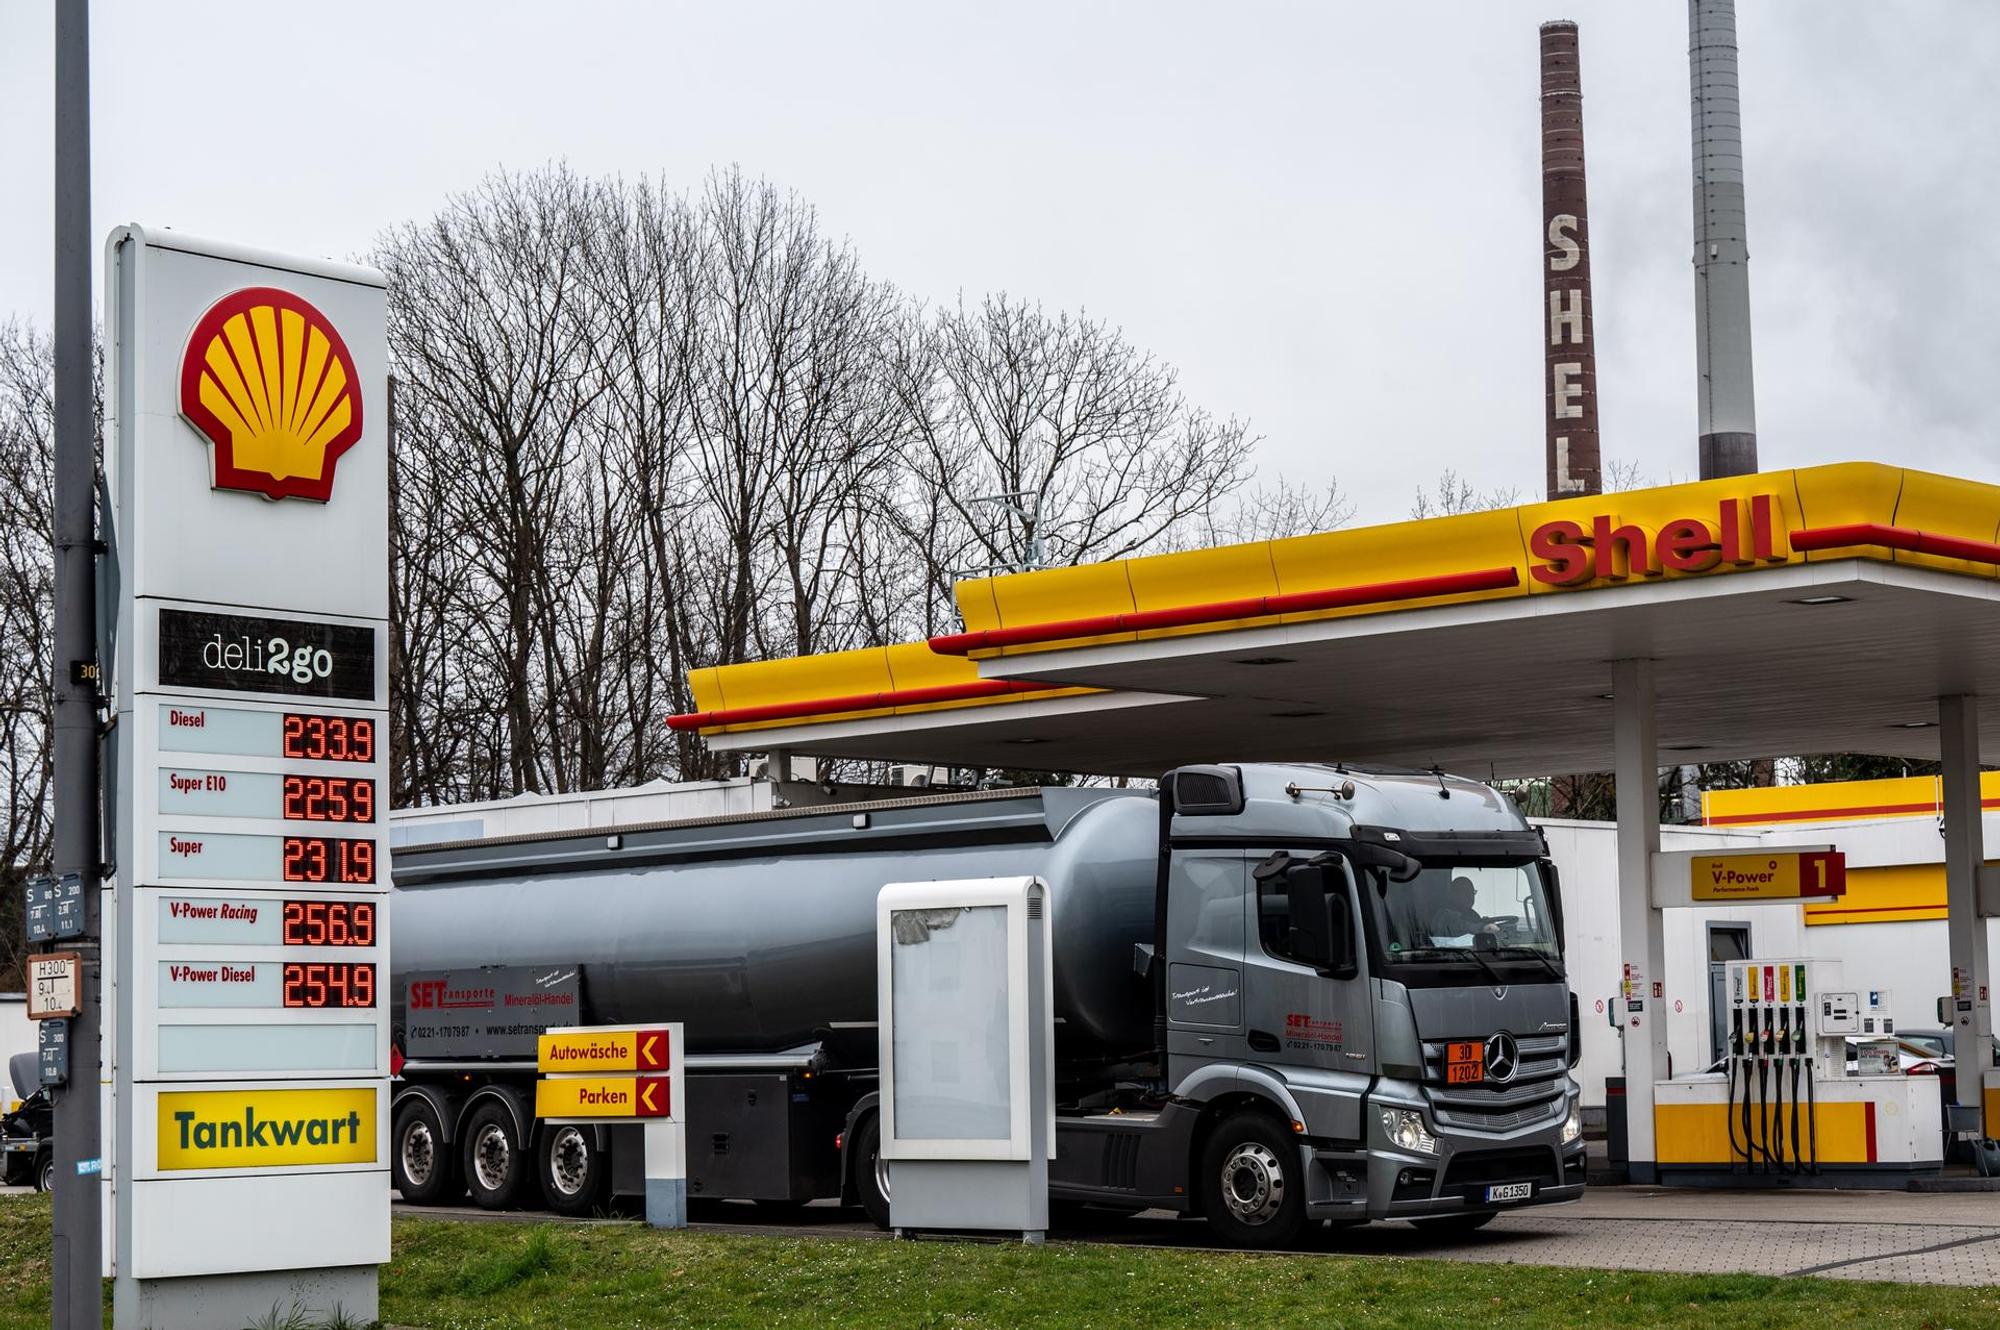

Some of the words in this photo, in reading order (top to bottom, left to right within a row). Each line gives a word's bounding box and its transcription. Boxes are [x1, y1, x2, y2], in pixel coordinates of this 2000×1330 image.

[203, 634, 333, 684] deli2go
[170, 710, 204, 727] Diesel
[285, 717, 372, 760] 233.9
[170, 773, 202, 794] Super
[206, 775, 226, 791] E10
[170, 837, 202, 857] Super
[285, 839, 372, 882] 231.9
[1712, 870, 1774, 884] V-Power
[1814, 859, 1826, 888] 1
[26, 888, 34, 902] S
[54, 884, 61, 898] S
[170, 902, 217, 918] V-Power
[220, 904, 258, 923] Racing
[285, 904, 372, 944] 256.9
[39, 960, 65, 976] H300
[170, 966, 217, 982] V-Power
[221, 966, 255, 982] Diesel
[285, 965, 373, 1006] 254.9
[504, 992, 573, 1008] Mineralöl-Handel
[40, 1030, 46, 1043] S
[550, 1040, 628, 1060] Autowäsche
[1459, 1044, 1472, 1060] 30
[1453, 1062, 1479, 1081] 1202
[579, 1086, 627, 1104] Parken
[174, 1106, 360, 1149] Tankwart
